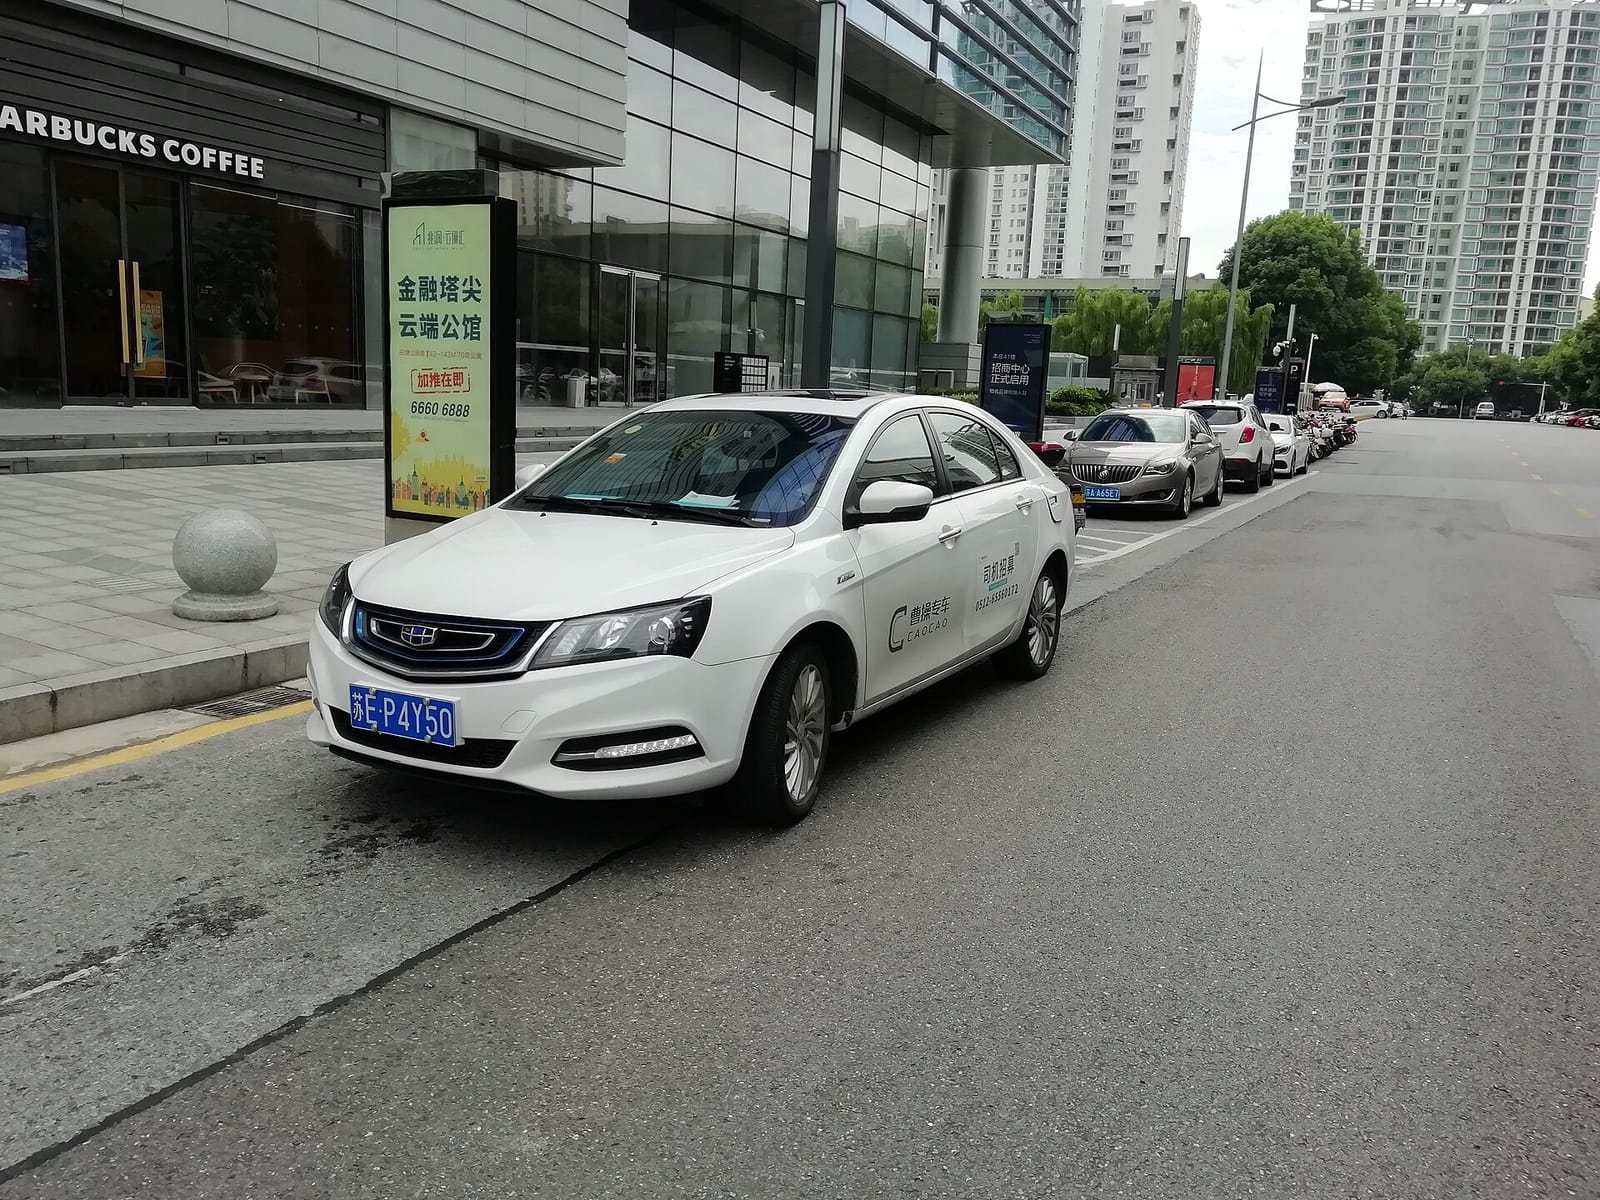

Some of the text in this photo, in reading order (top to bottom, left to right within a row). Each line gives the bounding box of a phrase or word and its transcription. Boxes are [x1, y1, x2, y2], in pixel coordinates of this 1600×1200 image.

[0, 105, 264, 179] ARBUCKS COFFEE
[397, 275, 481, 303] 金融塔尖
[398, 313, 482, 341] 云端公馆
[991, 363, 1030, 374] 招商中心
[1291, 366, 1298, 374] P
[417, 372, 464, 388] 加推在即
[990, 374, 1030, 386] 正式启用
[411, 401, 470, 417] 6660 6888
[911, 596, 951, 626] 曹操专车
[907, 617, 948, 642] CAOCAO
